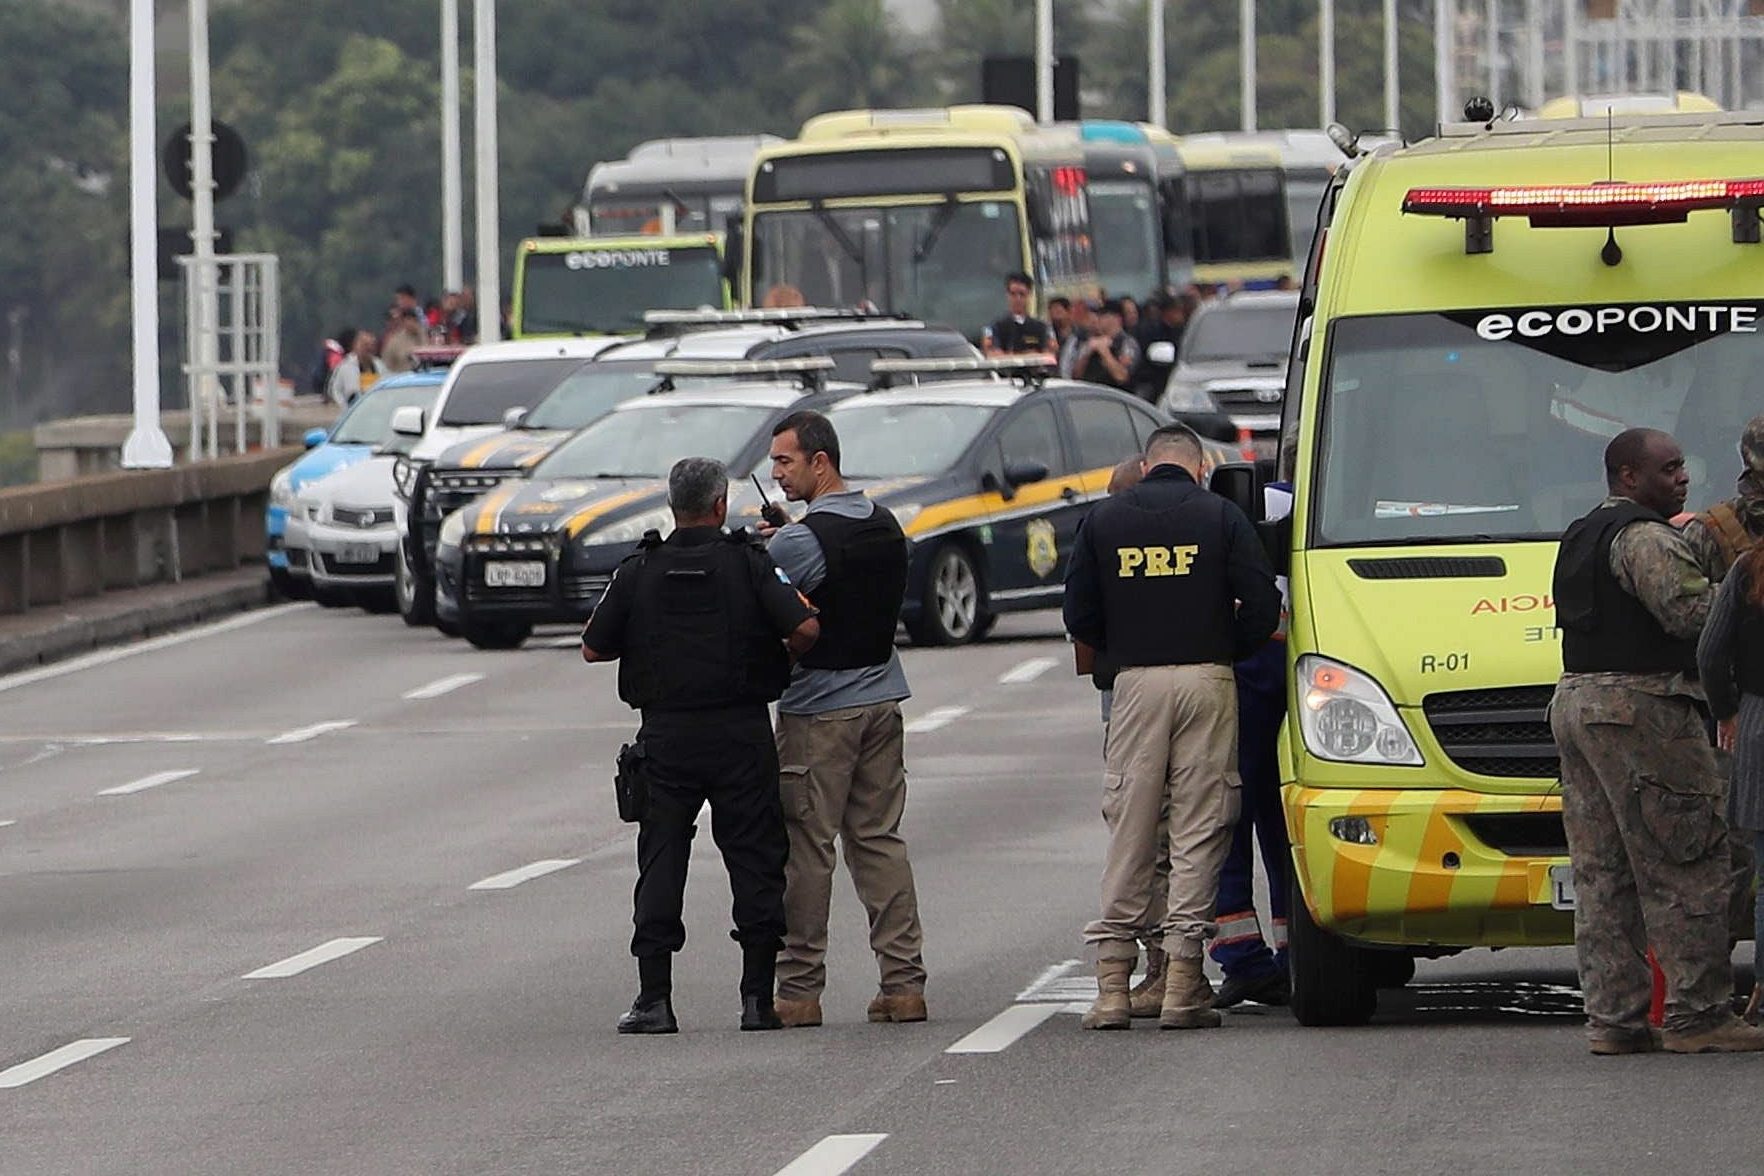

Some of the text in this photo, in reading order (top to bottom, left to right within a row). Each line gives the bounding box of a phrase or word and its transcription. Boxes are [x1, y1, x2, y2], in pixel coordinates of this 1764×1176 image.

[1476, 305, 1758, 341] ecoPONTE
[1117, 544, 1199, 577] PRF
[1421, 652, 1469, 674] R-01
